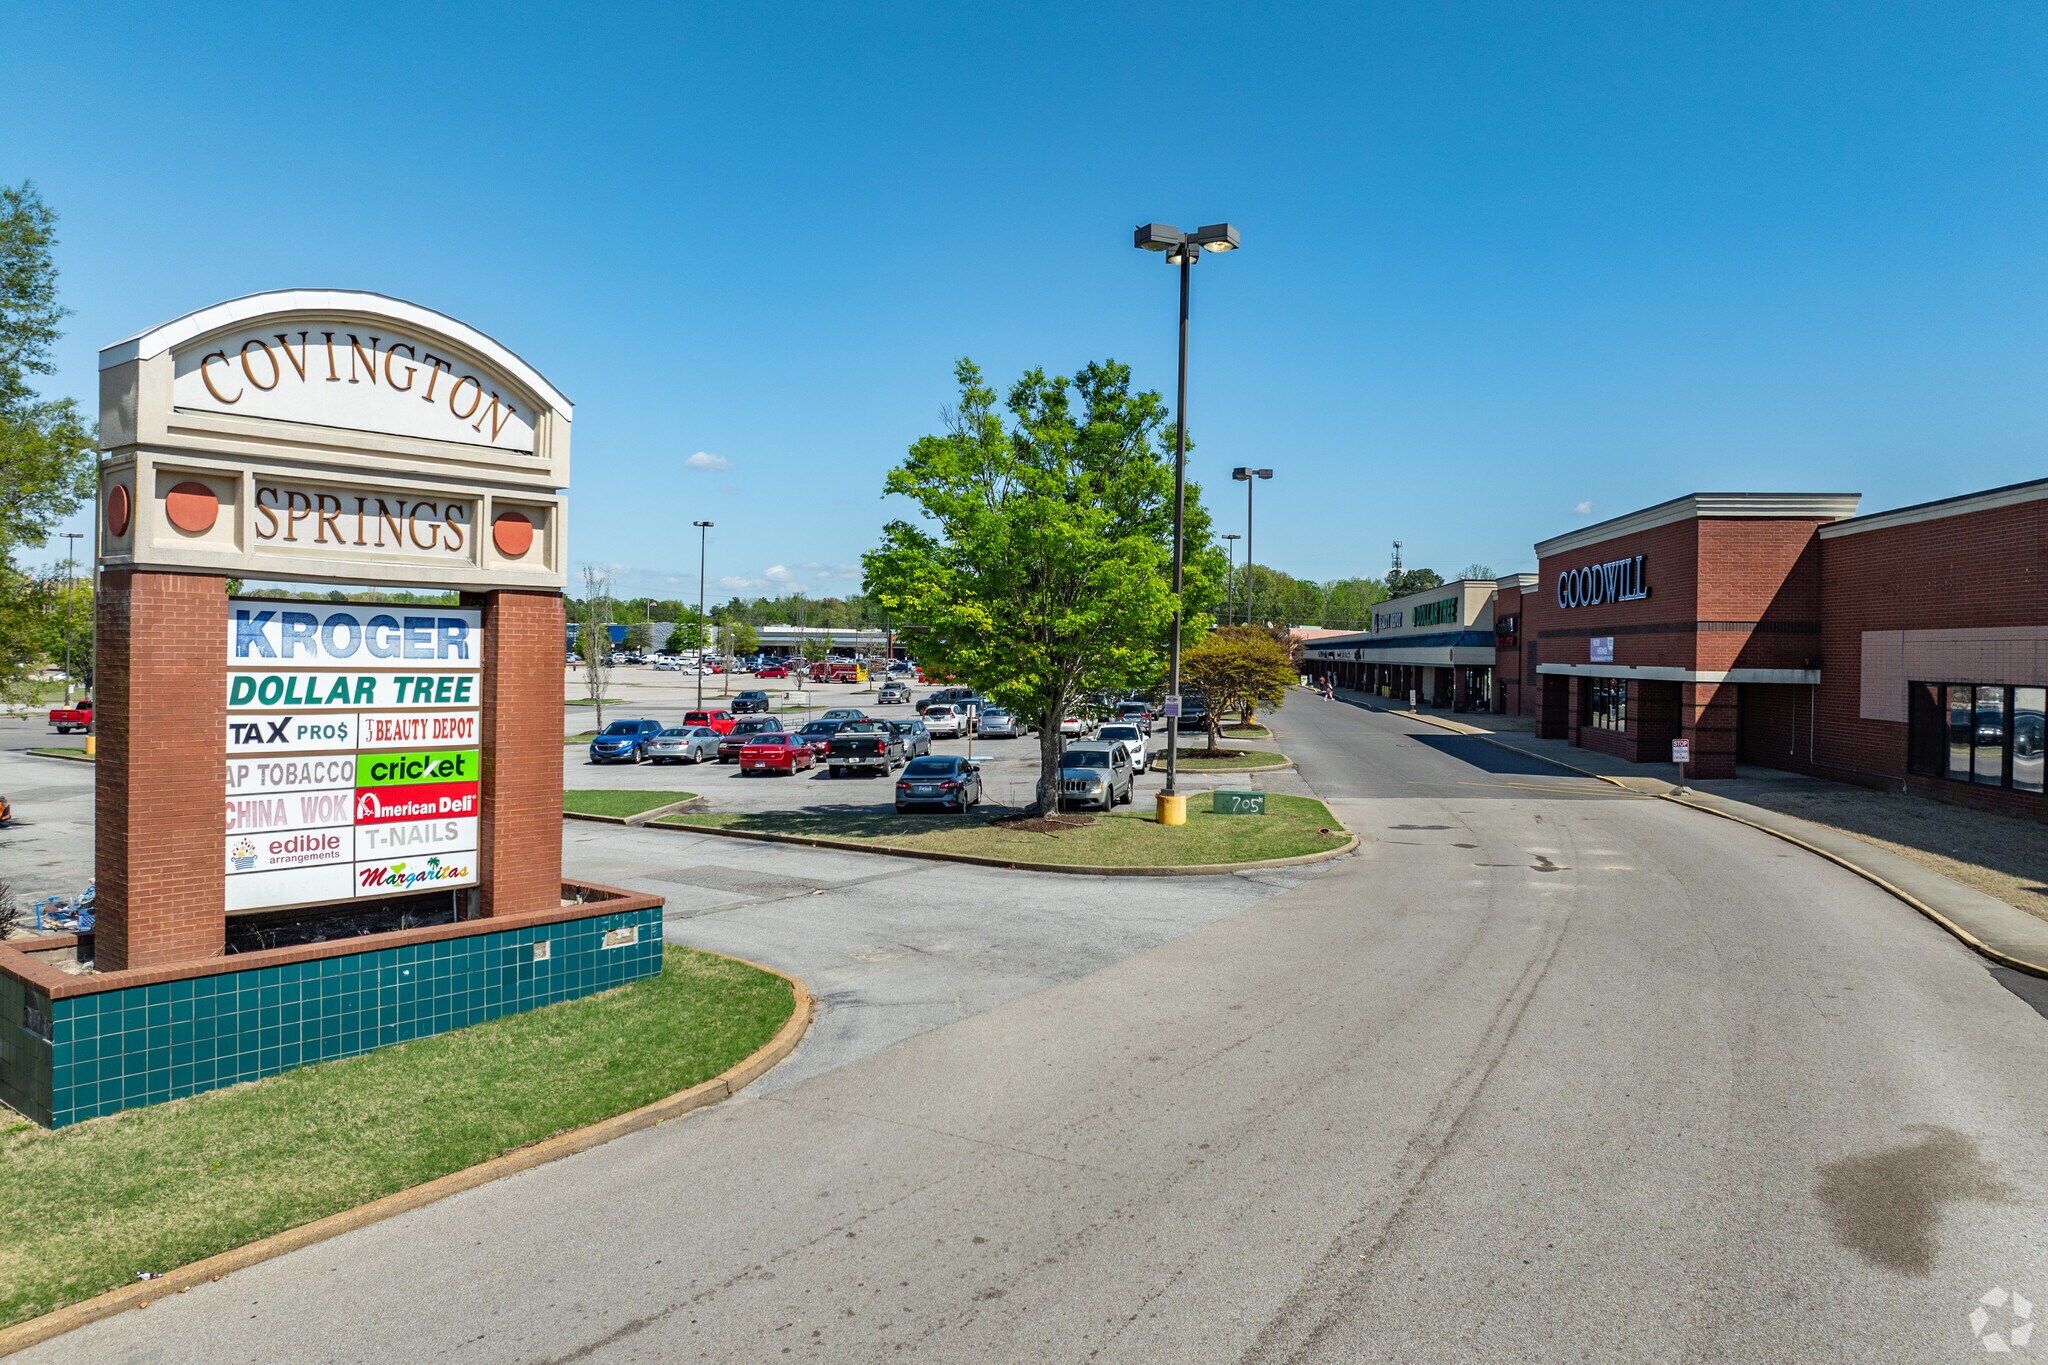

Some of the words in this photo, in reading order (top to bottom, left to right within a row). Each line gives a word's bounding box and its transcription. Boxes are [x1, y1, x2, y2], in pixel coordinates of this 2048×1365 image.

[200, 330, 517, 443] COVINGTON
[254, 486, 464, 551] SPRINGS
[1557, 555, 1648, 609] GOODWILL
[235, 609, 470, 660] KROGER
[229, 675, 377, 706] DOLLAR
[393, 676, 474, 704] TREE
[229, 716, 293, 745] TAX
[297, 721, 348, 743] PRO$
[375, 718, 429, 742] BEAUTY
[433, 717, 474, 740] DEPOT
[257, 760, 354, 787] TOBACCO
[370, 753, 466, 781] cricket
[226, 798, 288, 831] CHINA
[300, 794, 348, 824] WOK
[356, 792, 437, 820] American
[269, 833, 340, 854] edible
[365, 821, 459, 849] T-NAILS
[269, 850, 340, 865] arrangements
[359, 864, 469, 889] Margaritas
